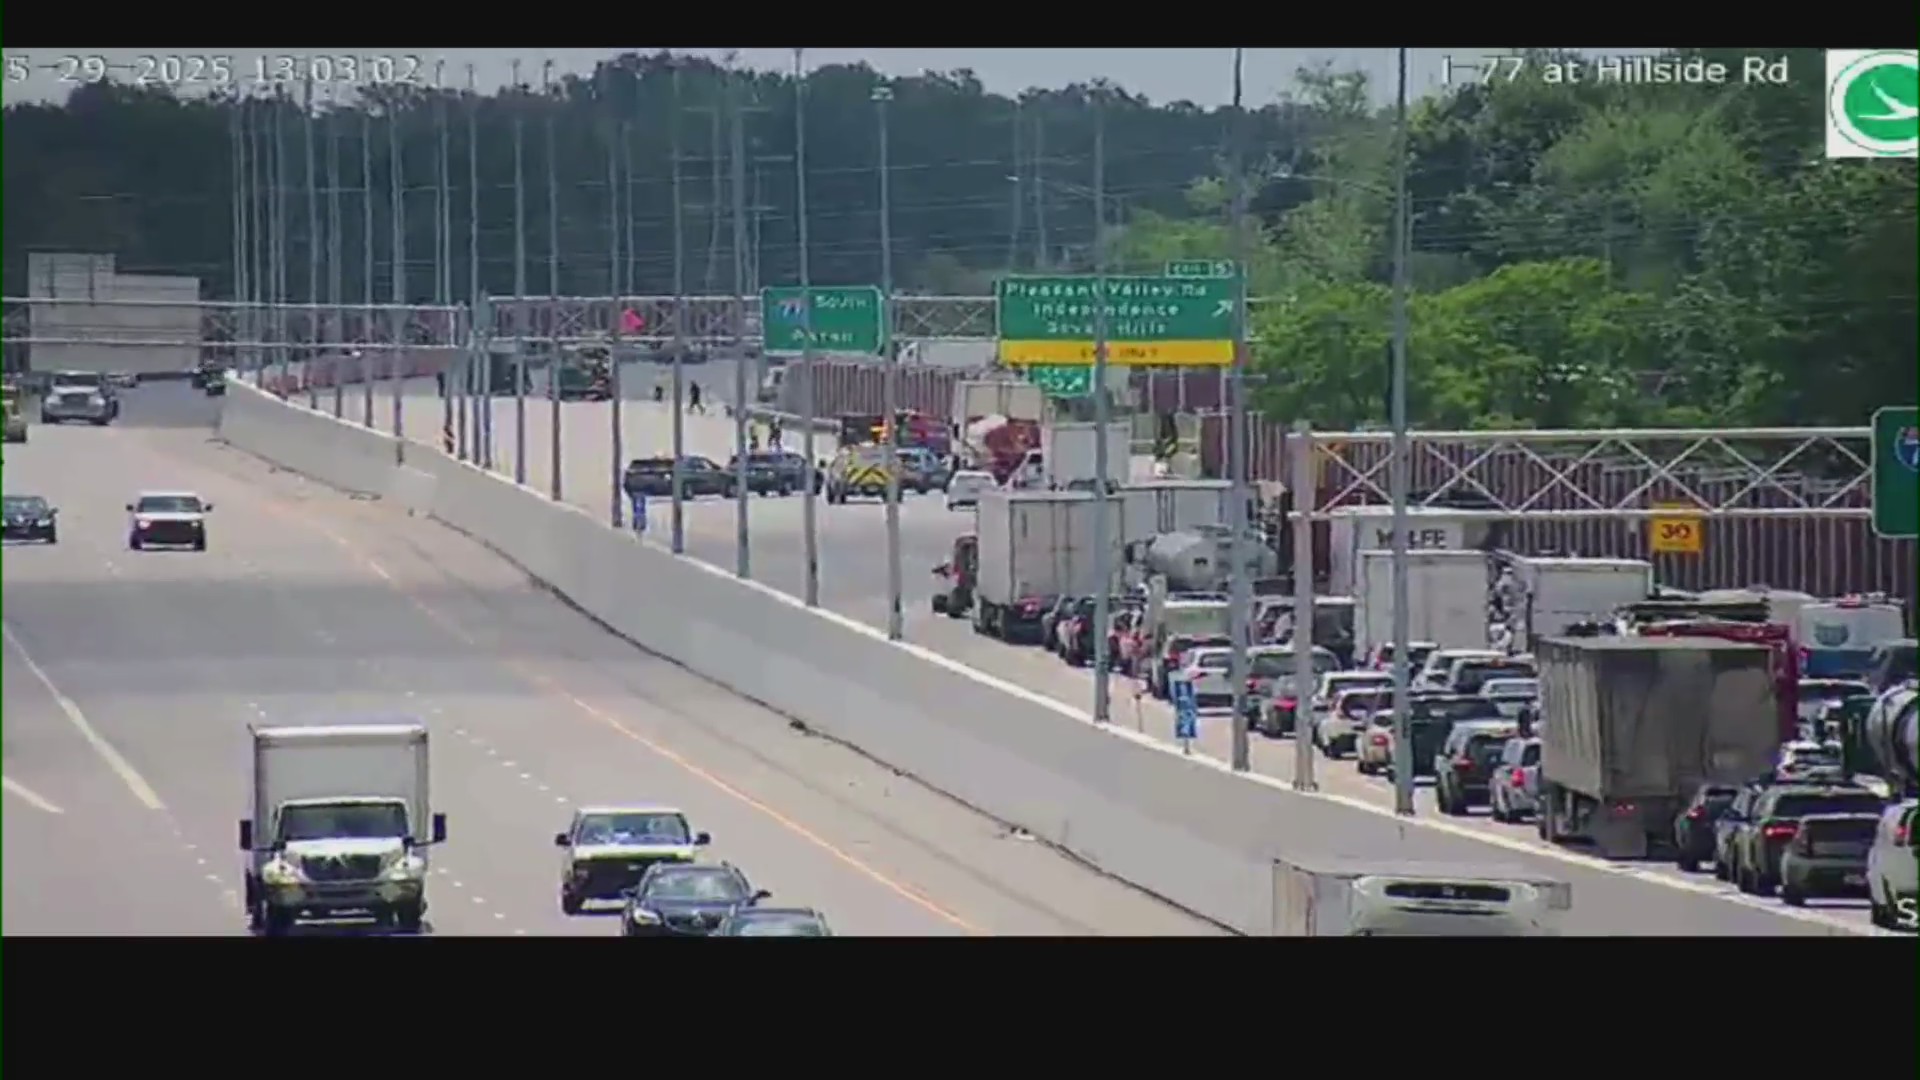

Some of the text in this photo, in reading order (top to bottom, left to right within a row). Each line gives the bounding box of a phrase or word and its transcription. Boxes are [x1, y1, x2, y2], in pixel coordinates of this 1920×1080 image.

[1005, 282, 1098, 297] Pleasant
[1107, 282, 1174, 298] Valley
[1033, 300, 1180, 317] Indepndence
[1376, 528, 1448, 549] WLFE
[1661, 522, 1691, 540] 30
